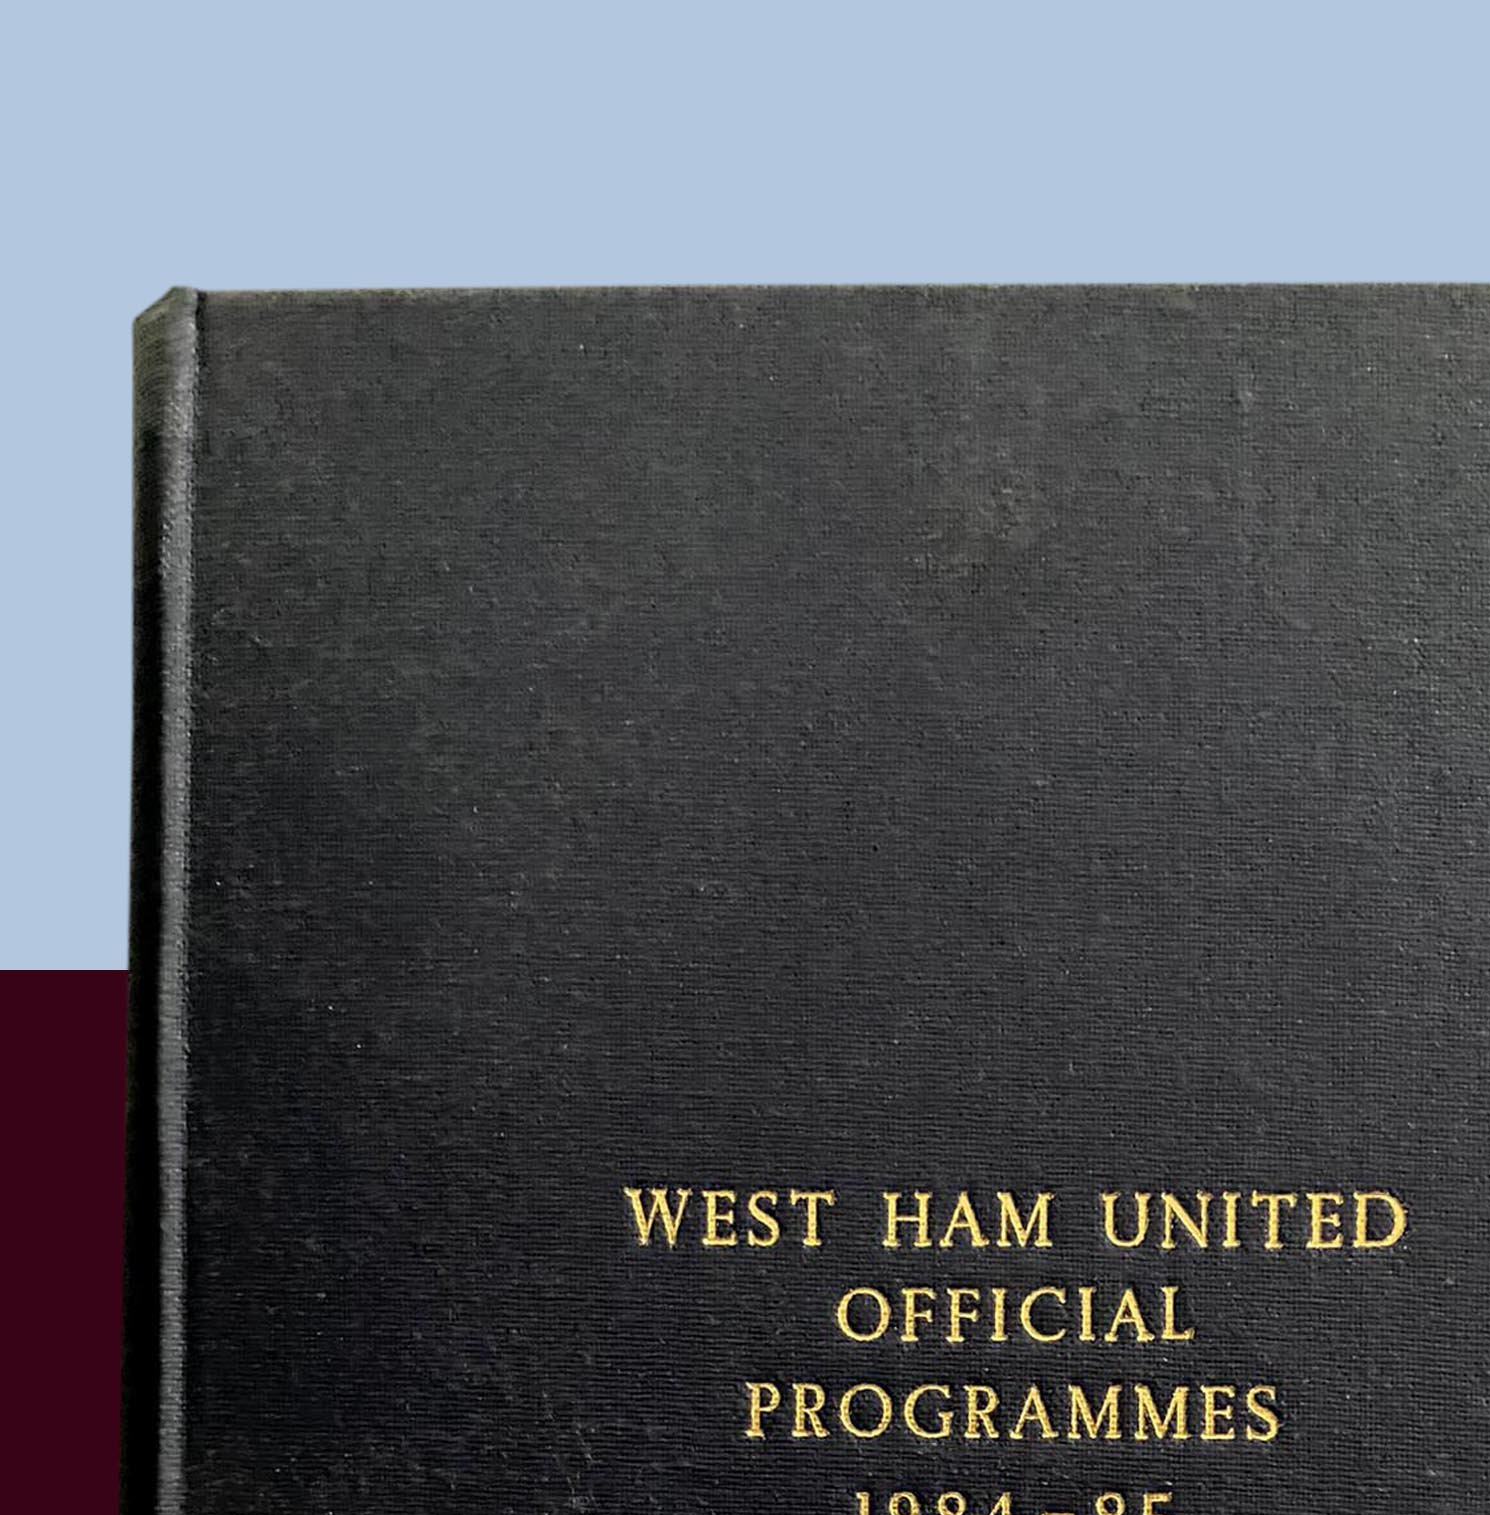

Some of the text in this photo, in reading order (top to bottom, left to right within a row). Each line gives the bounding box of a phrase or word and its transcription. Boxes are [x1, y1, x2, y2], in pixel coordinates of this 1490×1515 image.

[625, 1187, 1408, 1250] WEST HAM UNITED
[835, 1286, 1196, 1344] OFFICIAL
[745, 1382, 1281, 1443] PROGRAMMES
